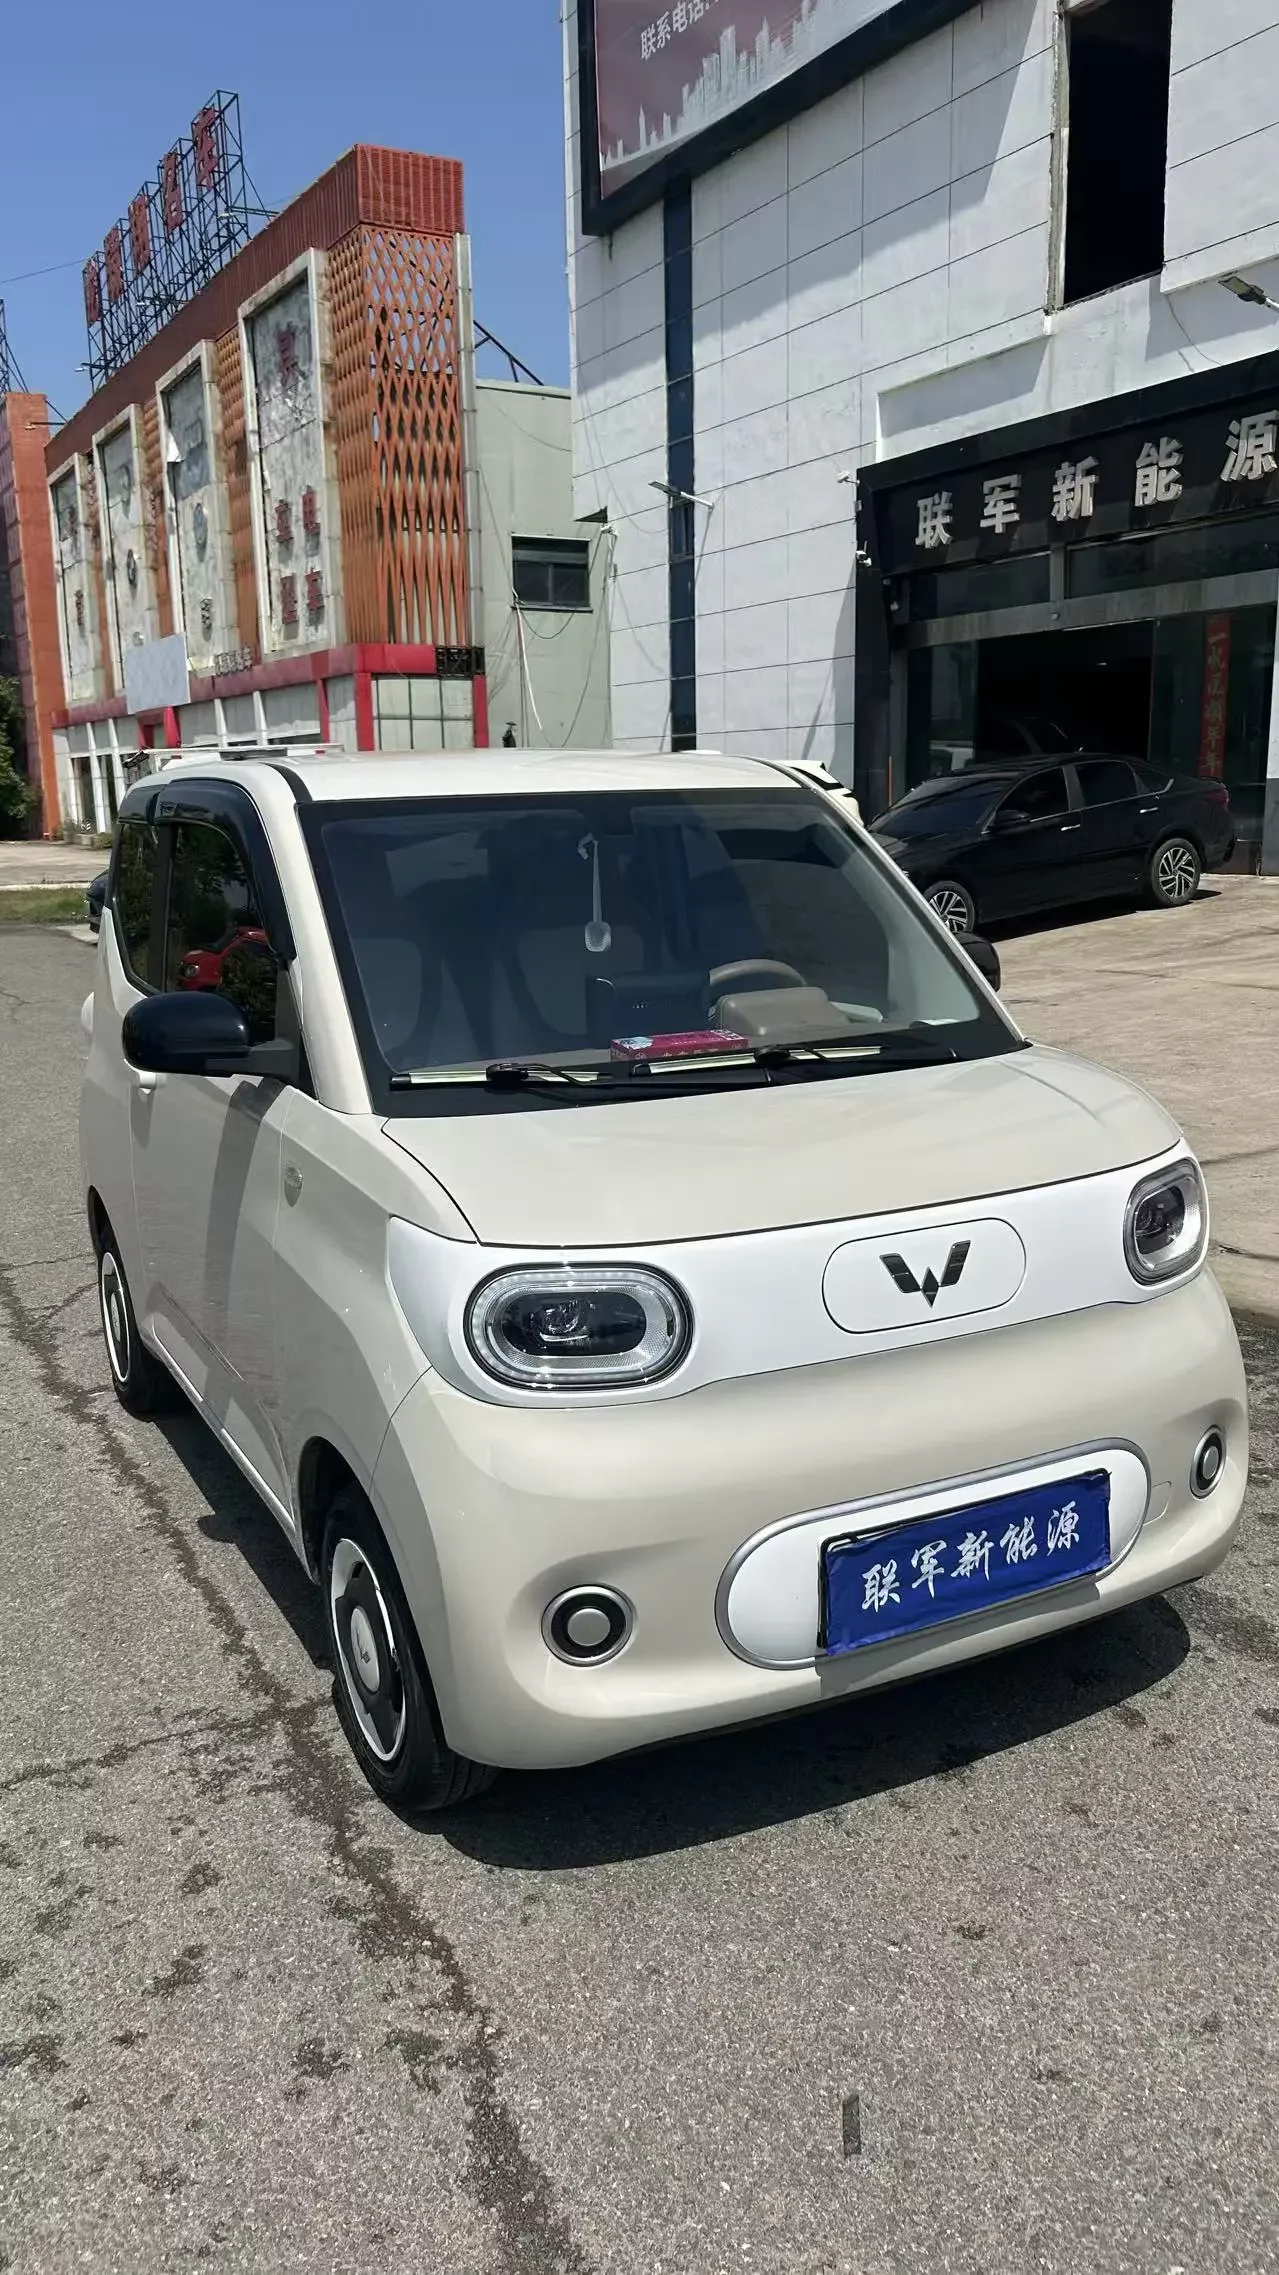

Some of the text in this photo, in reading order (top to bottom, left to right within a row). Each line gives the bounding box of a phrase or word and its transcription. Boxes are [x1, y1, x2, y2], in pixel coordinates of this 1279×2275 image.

[914, 410, 1279, 549] 联军新能源
[862, 1500, 1081, 1612] 联军新能源
